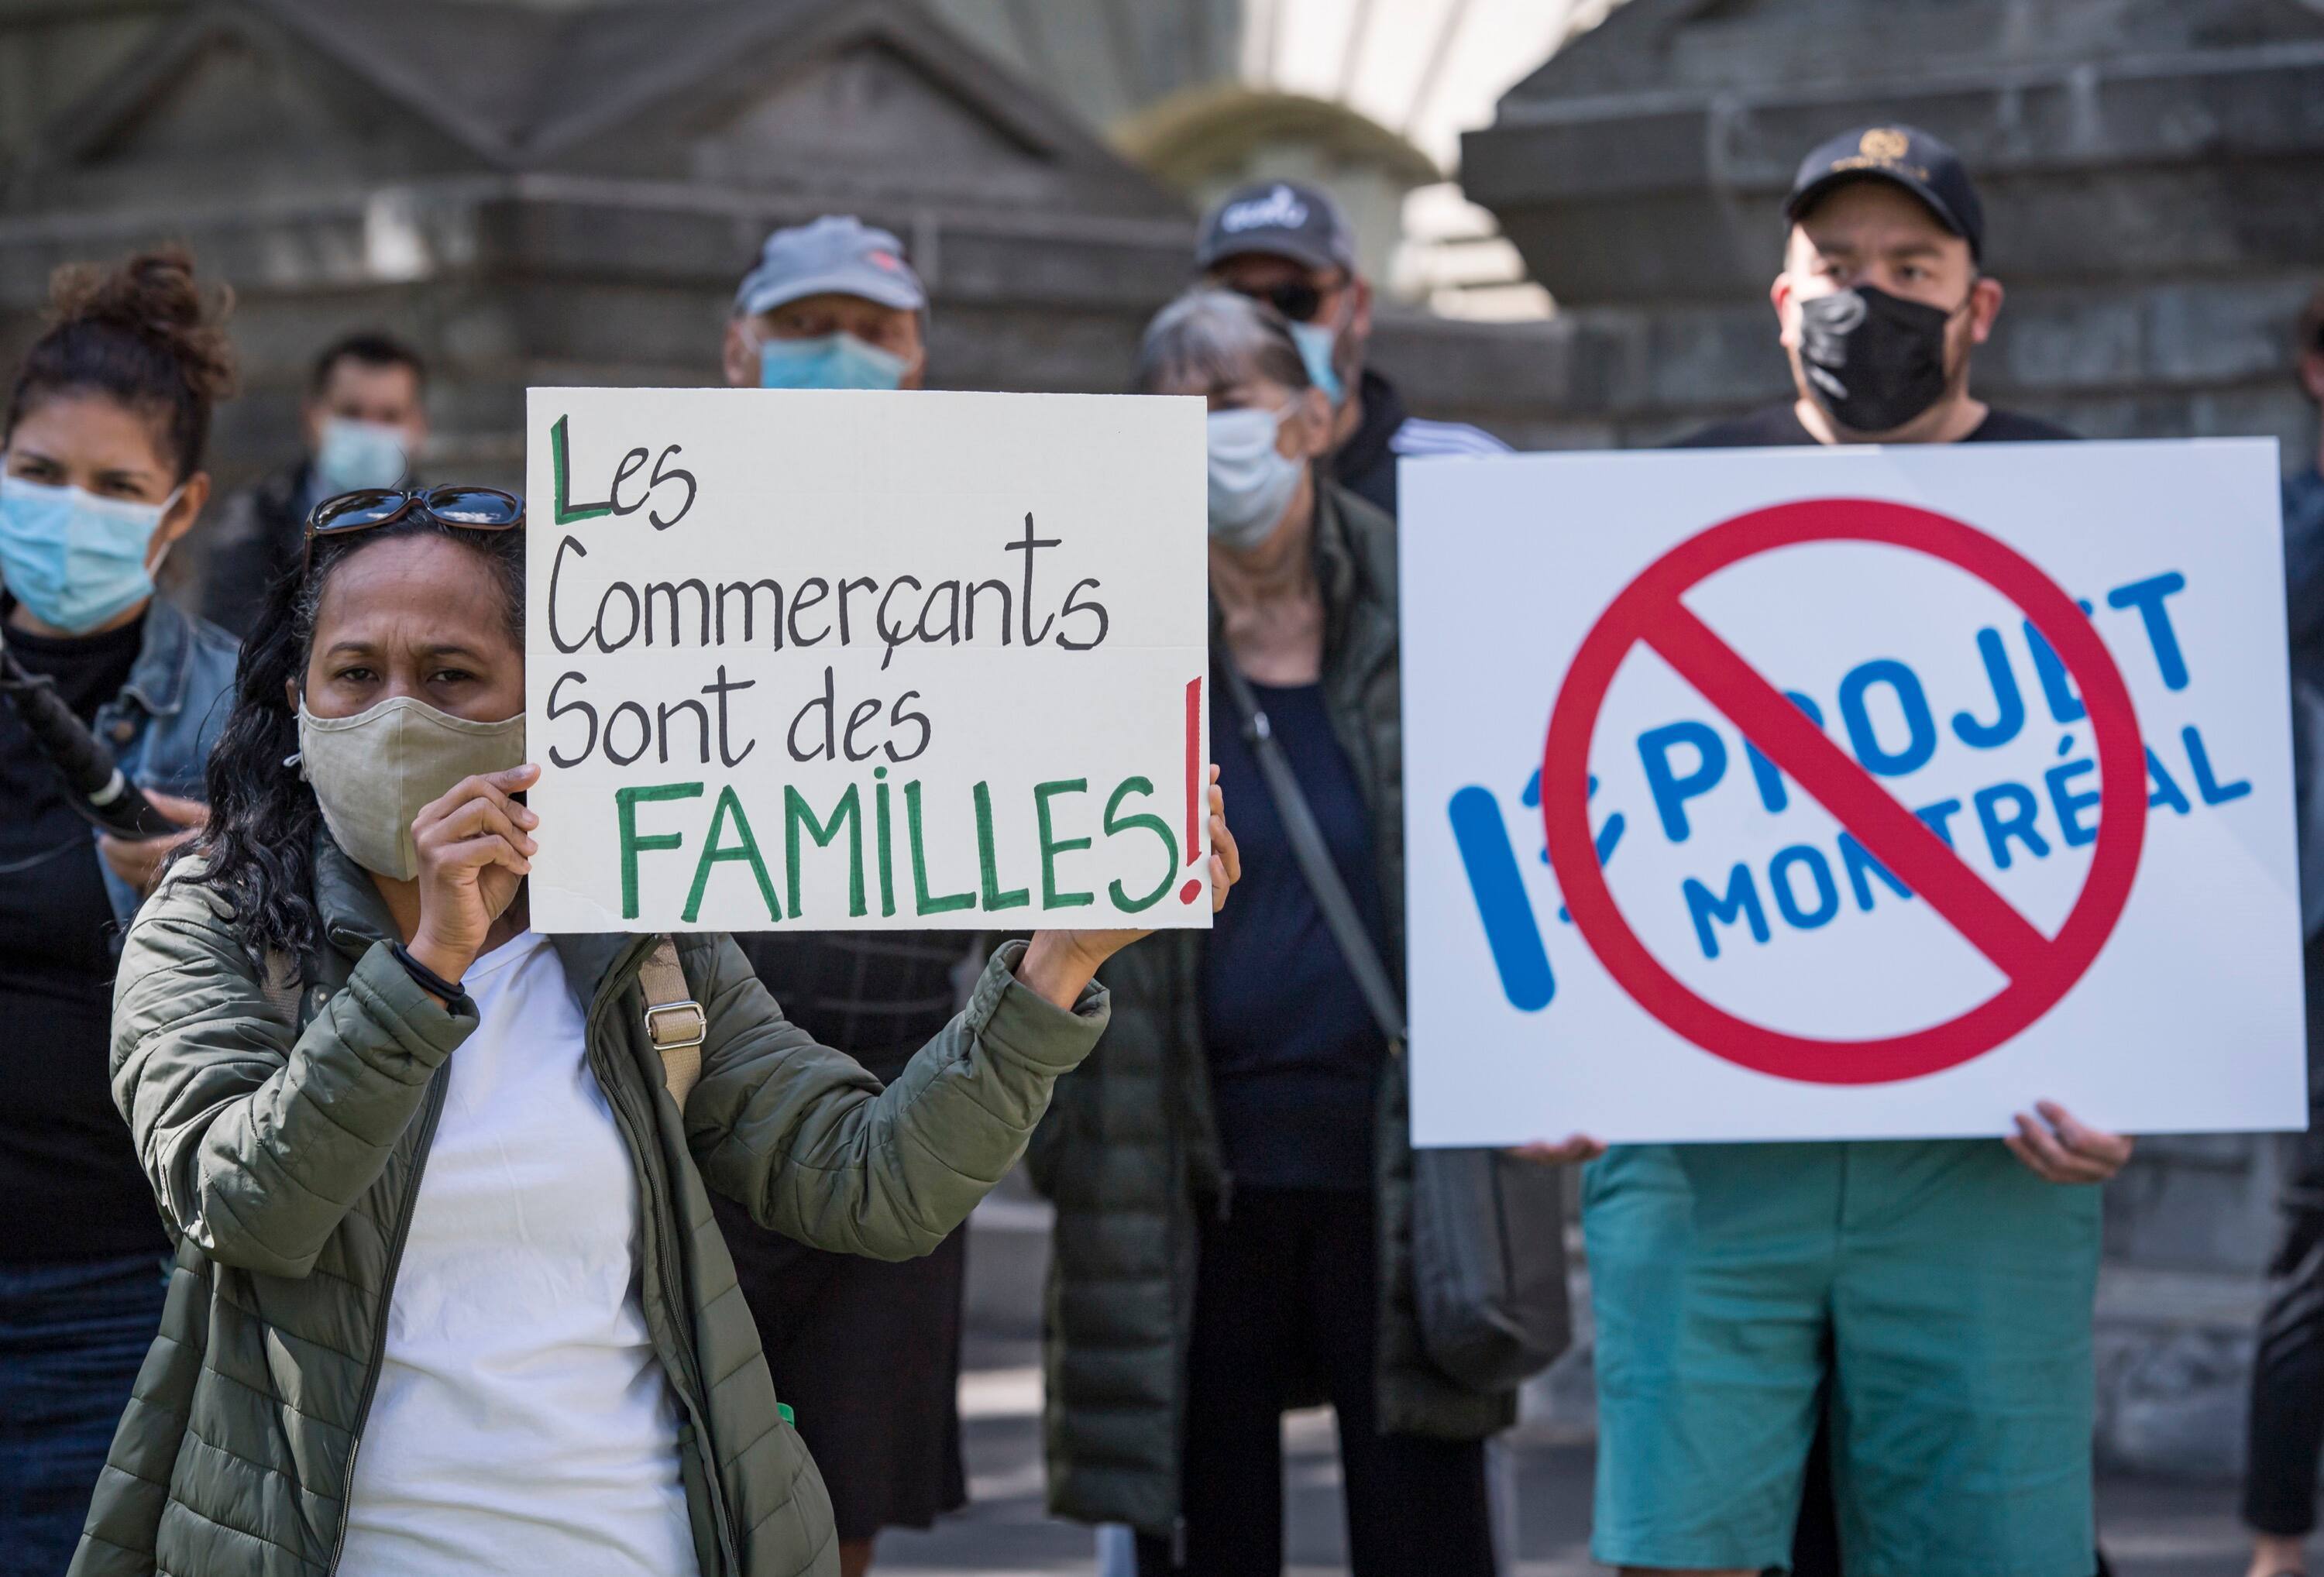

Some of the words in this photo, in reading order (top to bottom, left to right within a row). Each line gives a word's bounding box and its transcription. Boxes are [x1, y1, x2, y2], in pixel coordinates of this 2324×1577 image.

[549, 414, 697, 531] Les
[548, 511, 1109, 672] Commerçants
[546, 664, 756, 769] Sont
[786, 665, 932, 763] des
